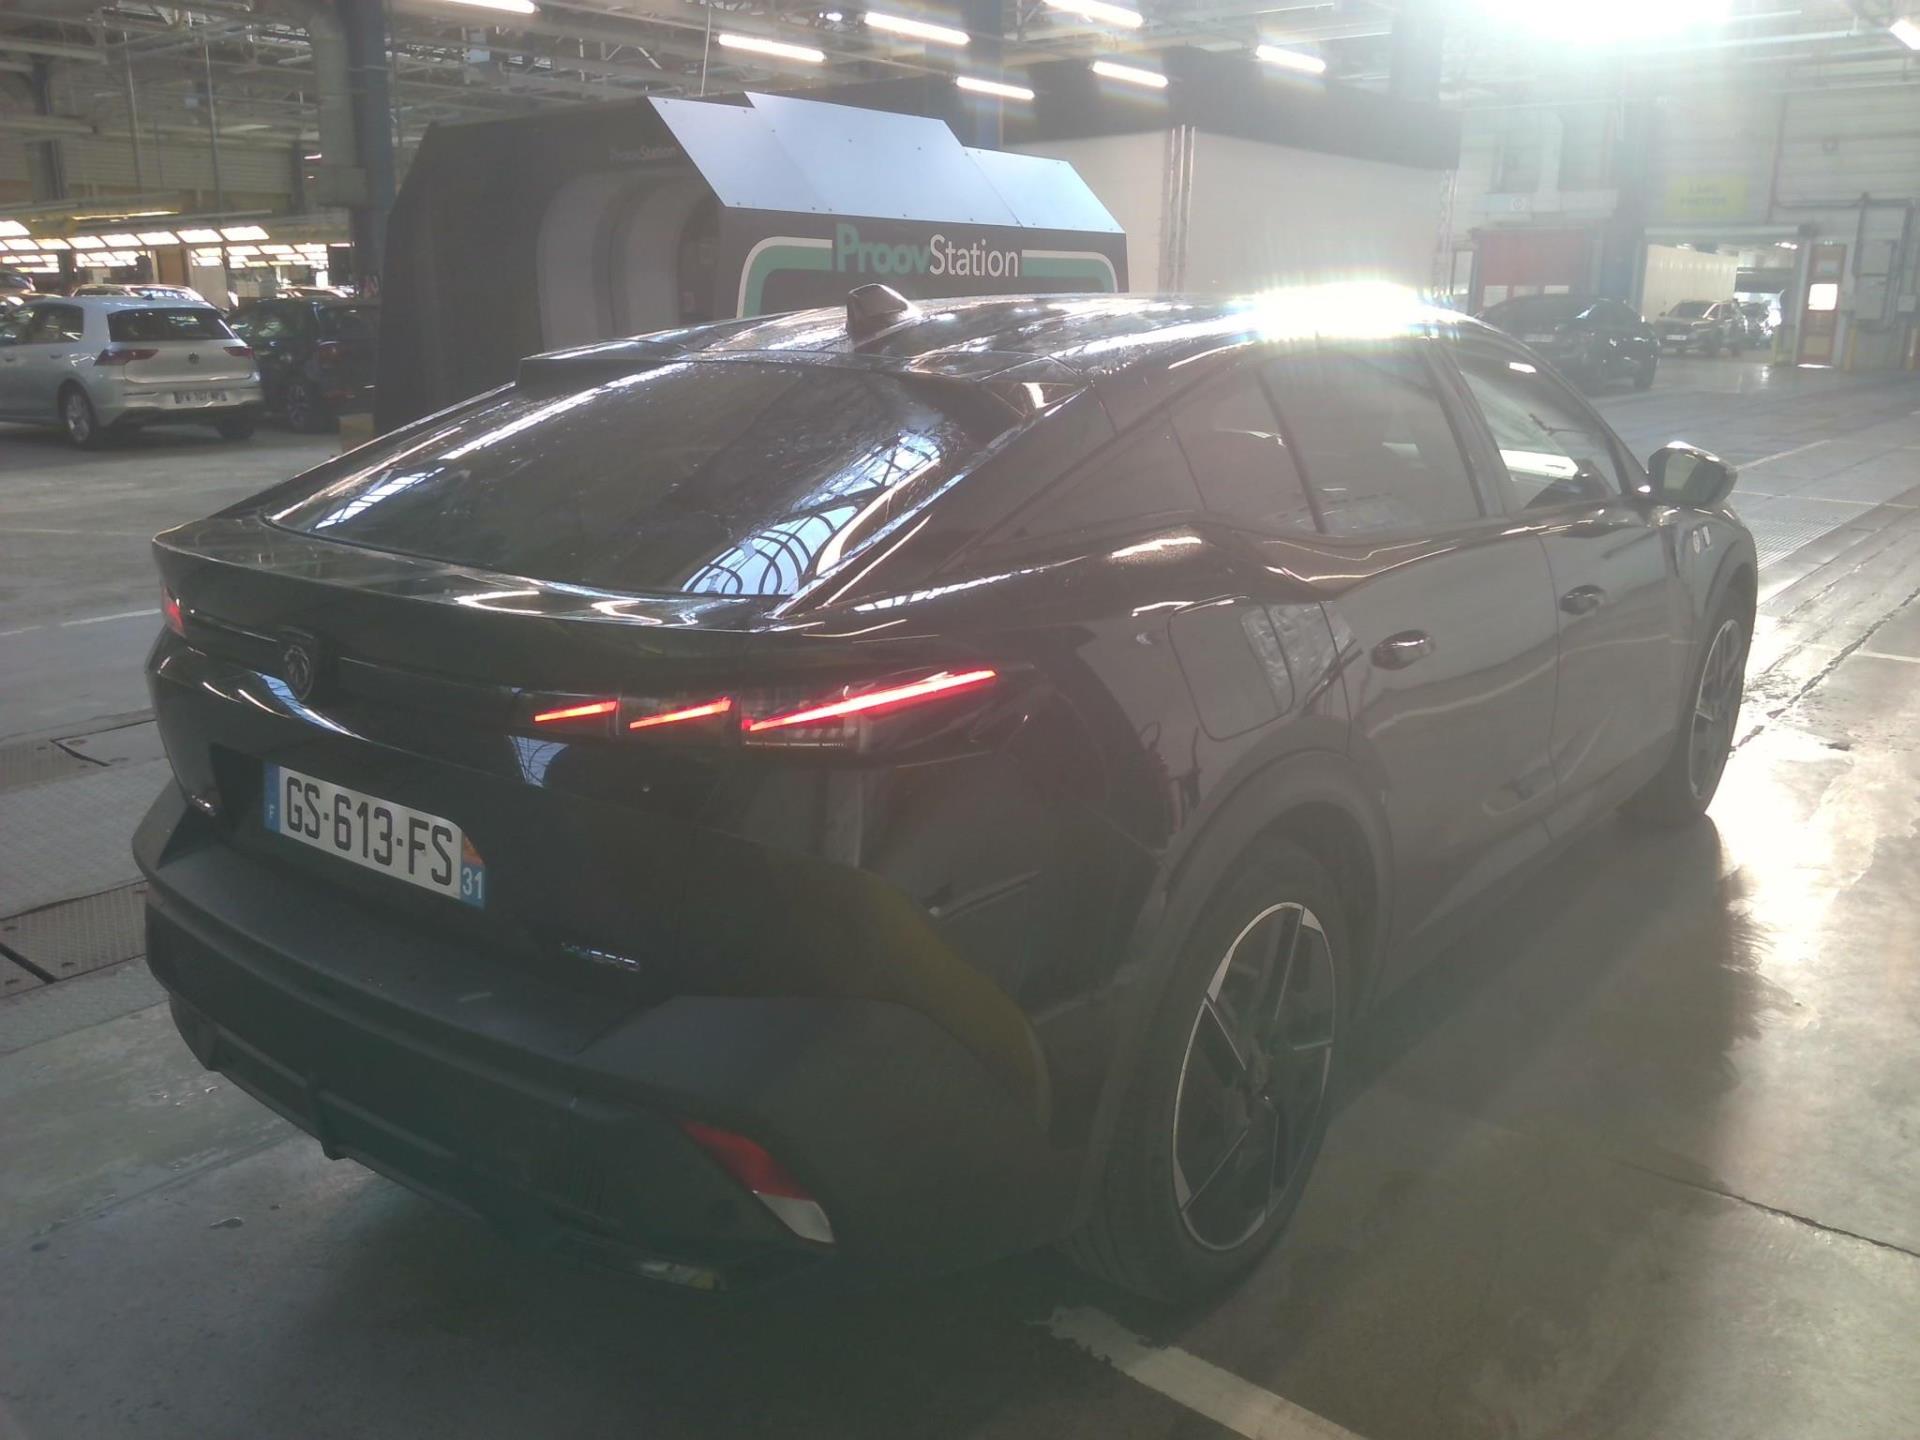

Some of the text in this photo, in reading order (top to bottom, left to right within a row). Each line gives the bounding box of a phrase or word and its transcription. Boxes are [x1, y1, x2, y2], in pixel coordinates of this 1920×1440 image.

[268, 776, 483, 899] F GS-613-FS 31
